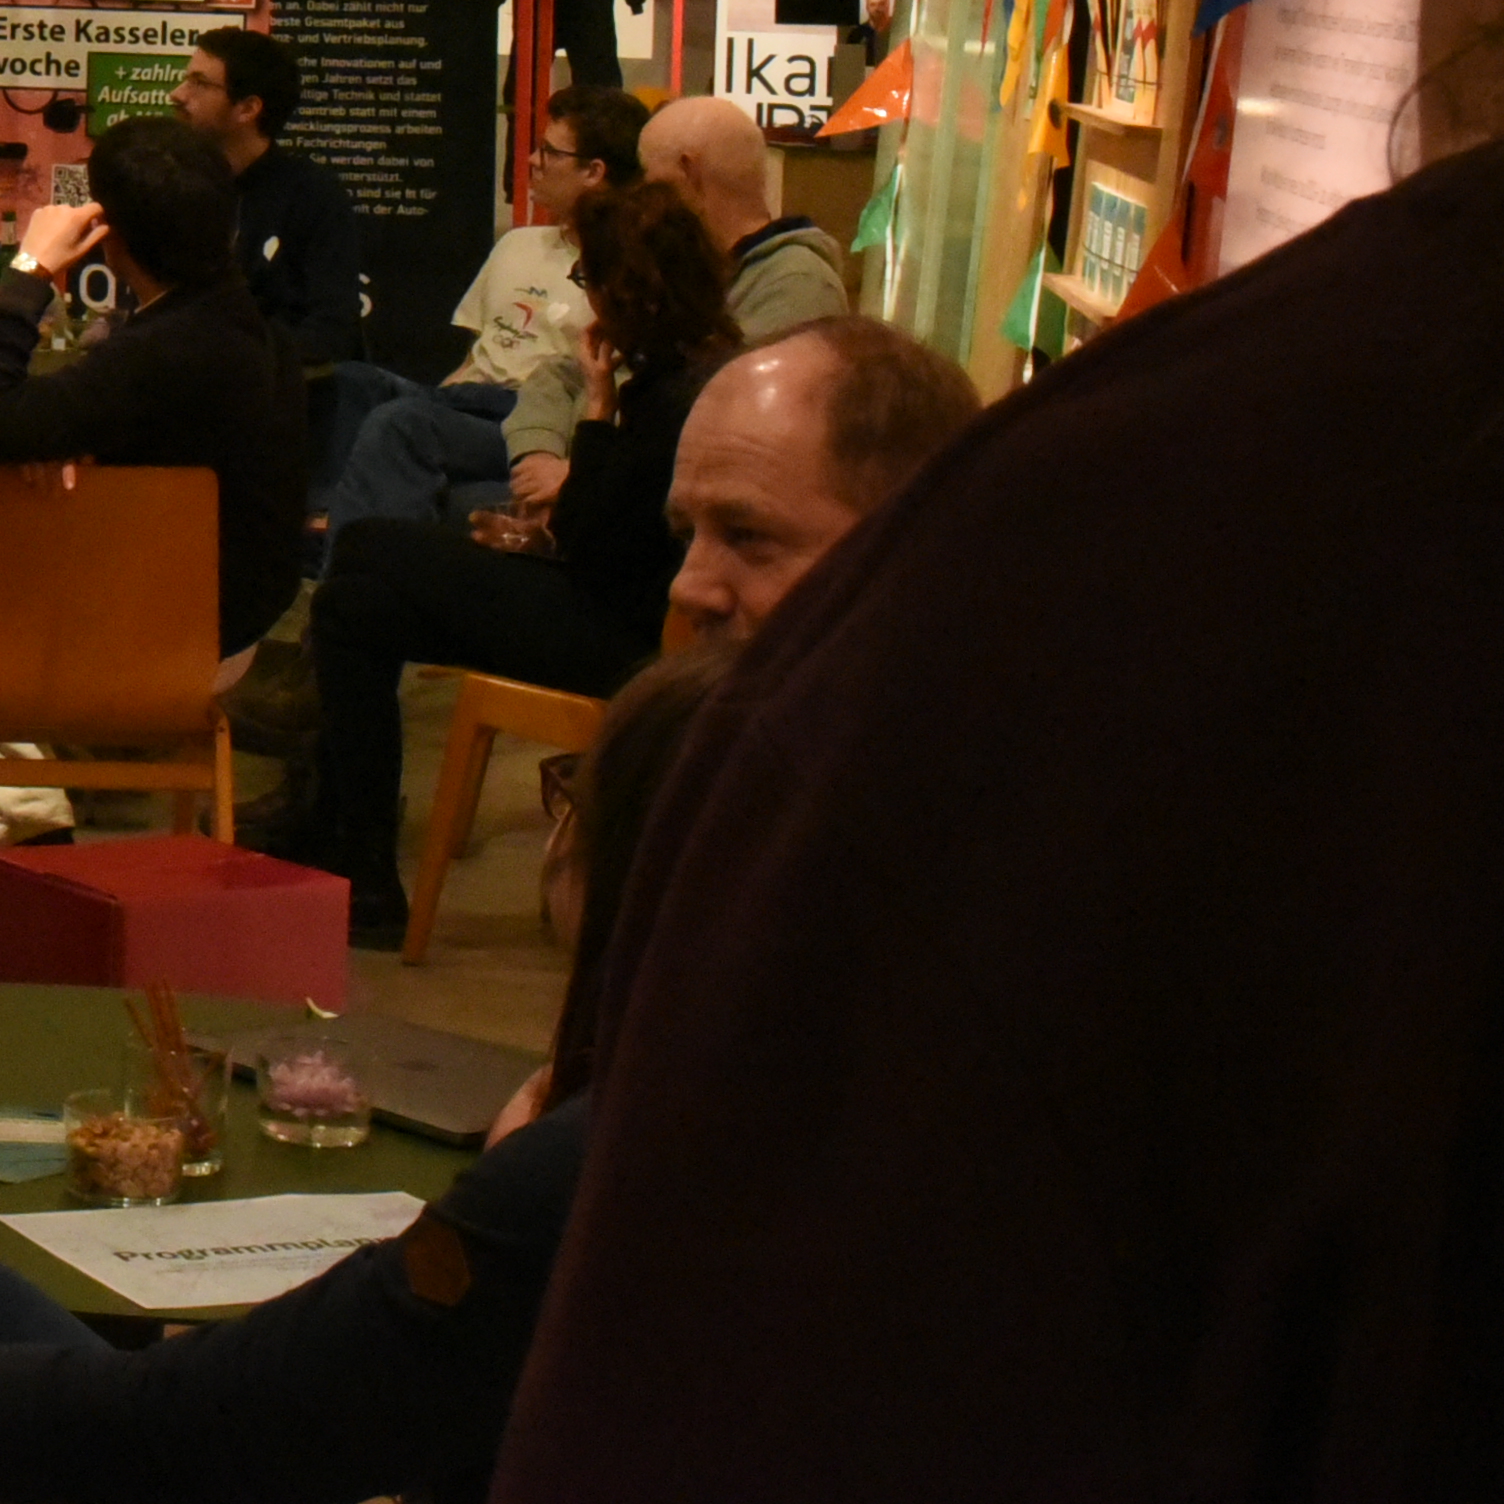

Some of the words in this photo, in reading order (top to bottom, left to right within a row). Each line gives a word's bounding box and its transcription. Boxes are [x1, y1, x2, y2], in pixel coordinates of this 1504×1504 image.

[306, 0, 339, 12] Dabei
[375, 2, 405, 12] nicht
[384, 20, 405, 29] aus
[74, 18, 200, 47] Kasseler
[297, 33, 319, 44] und
